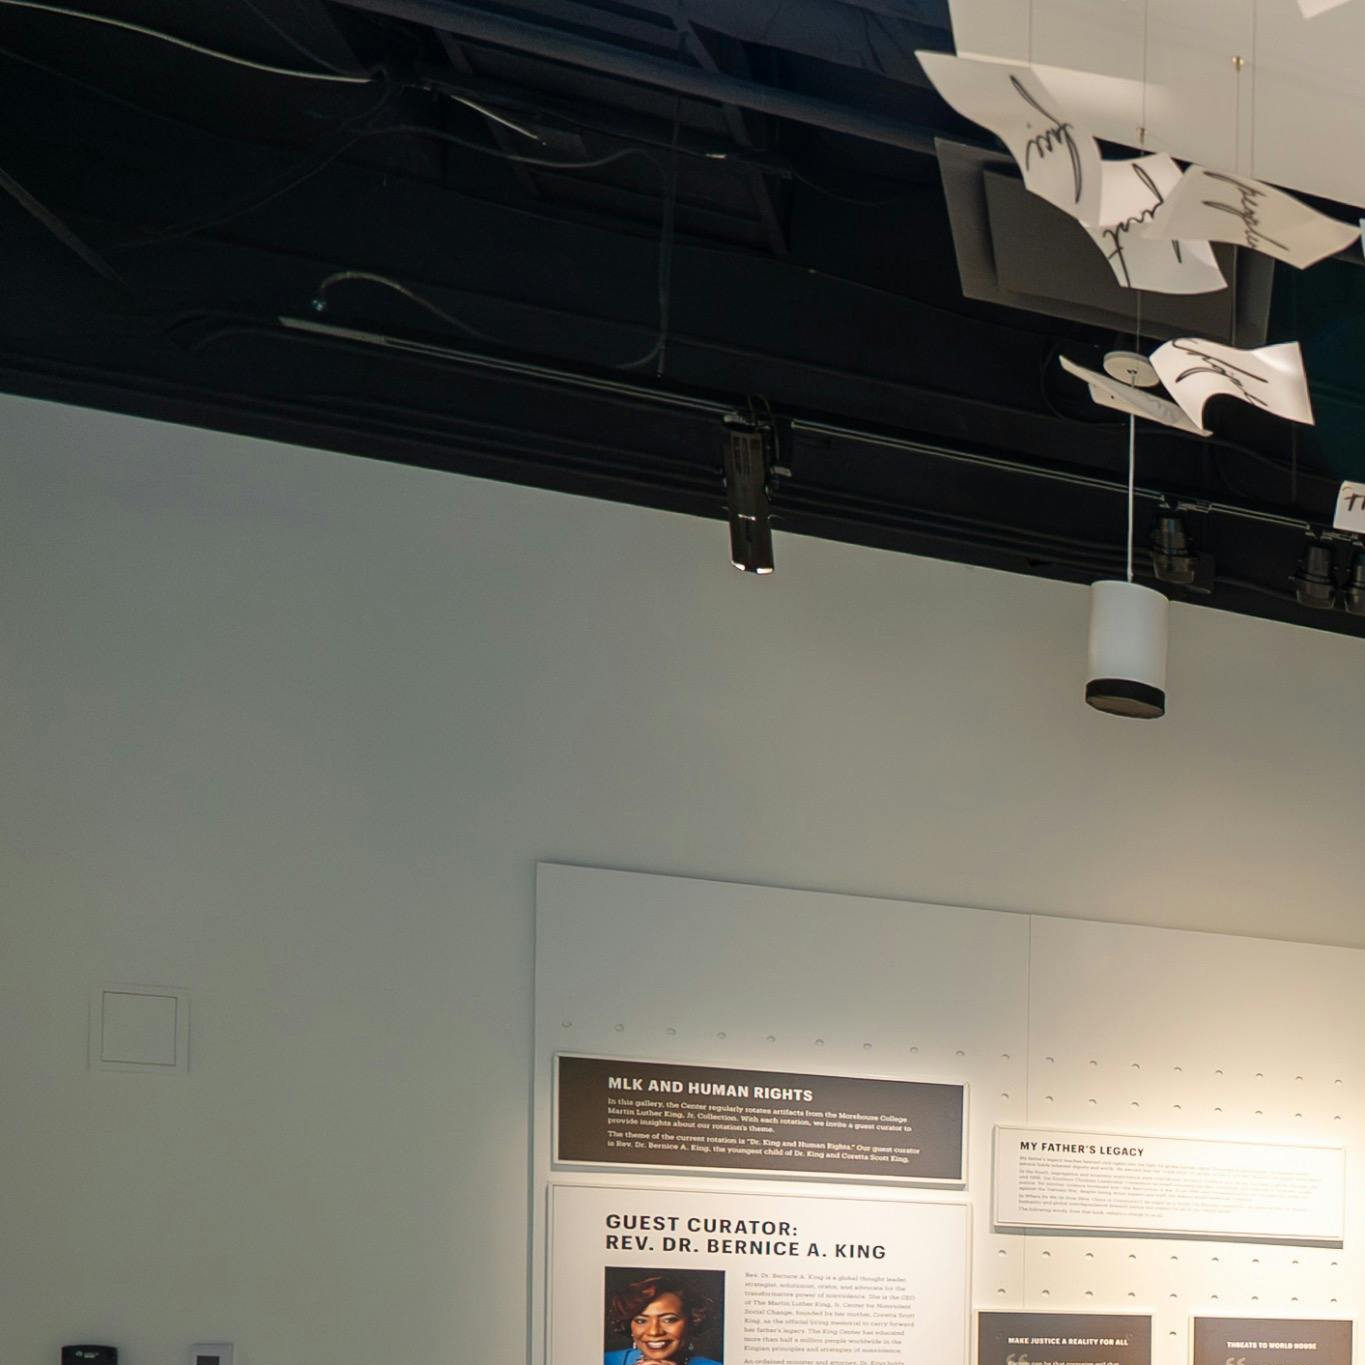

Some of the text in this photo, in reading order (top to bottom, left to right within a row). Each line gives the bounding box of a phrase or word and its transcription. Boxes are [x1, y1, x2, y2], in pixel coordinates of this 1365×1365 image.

[608, 1076, 813, 1102] MLK AND HUMAN RIGHTS
[1020, 1141, 1144, 1157] MY FATHER'S LEGACY
[605, 1214, 799, 1237] GUEST CURATOR:
[605, 1235, 887, 1260] REV. DR. BERNICE A. KING
